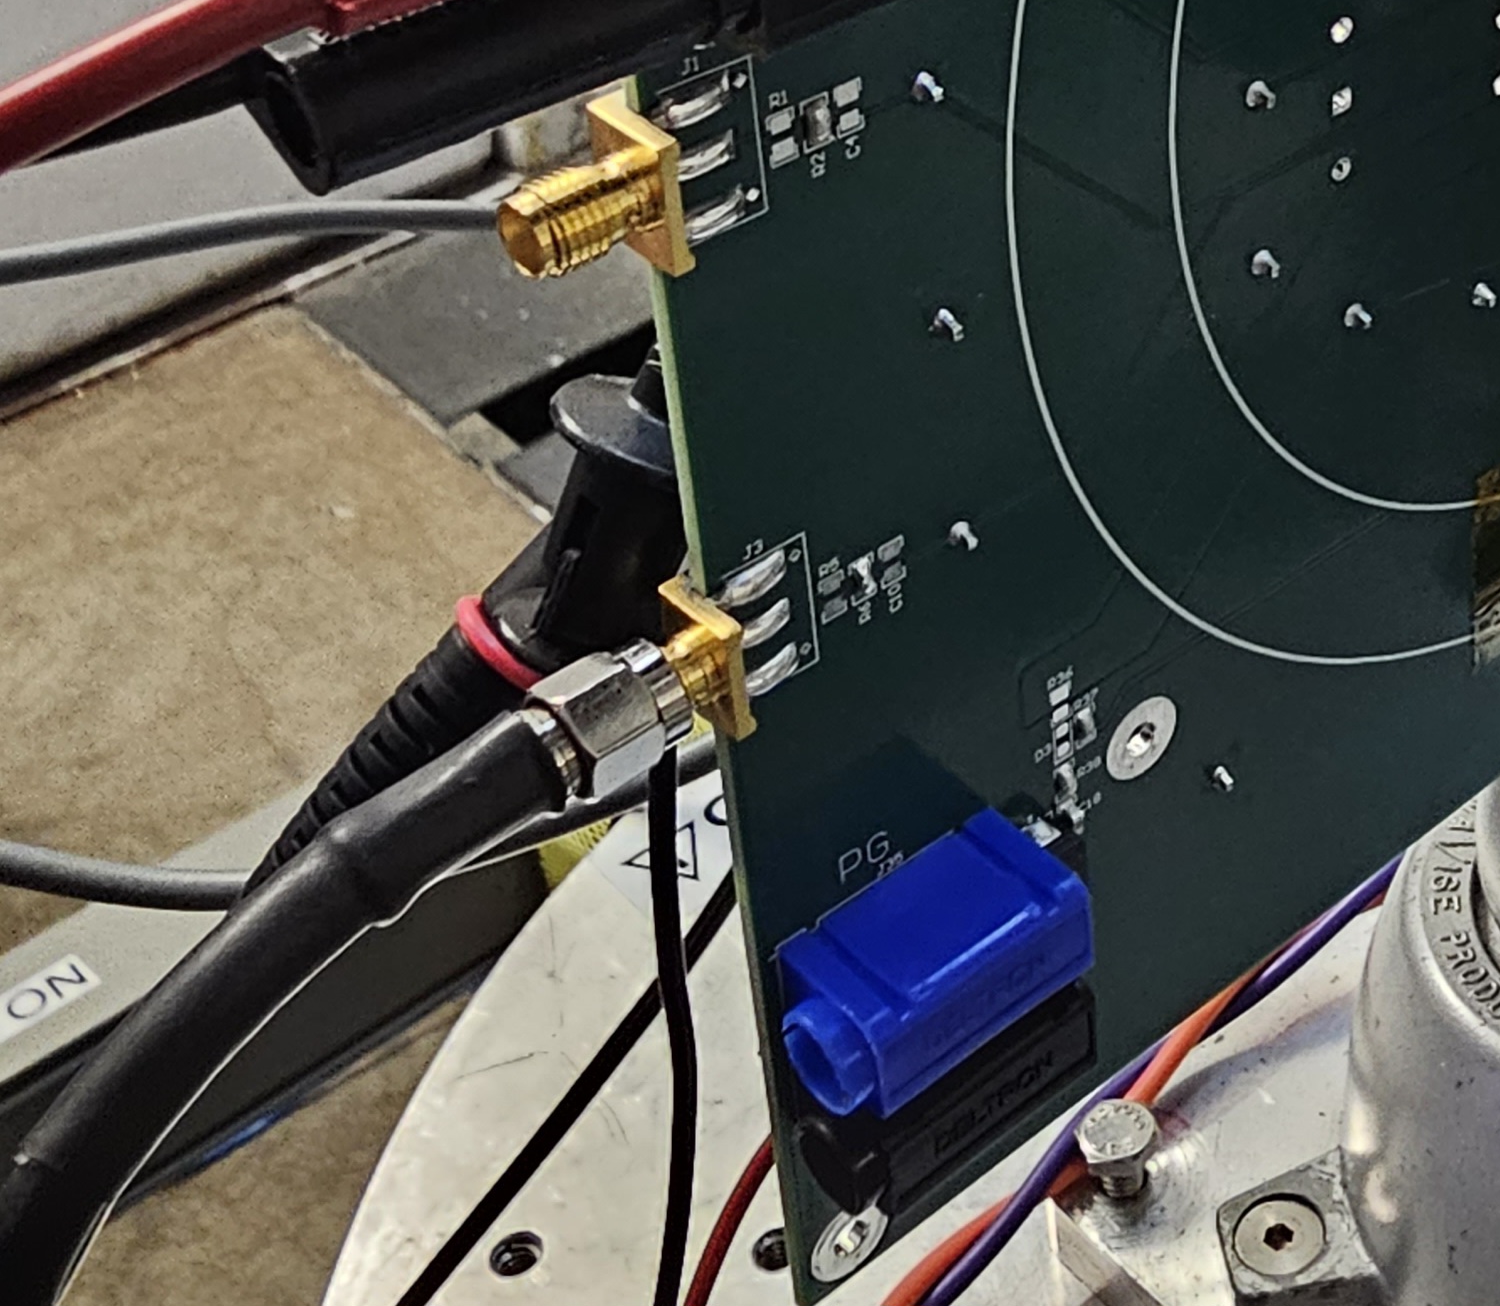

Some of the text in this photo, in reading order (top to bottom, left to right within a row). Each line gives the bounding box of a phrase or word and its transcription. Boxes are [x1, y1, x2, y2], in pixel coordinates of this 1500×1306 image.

[681, 56, 699, 76] J1
[769, 89, 788, 110] R1
[838, 830, 889, 886] PG
